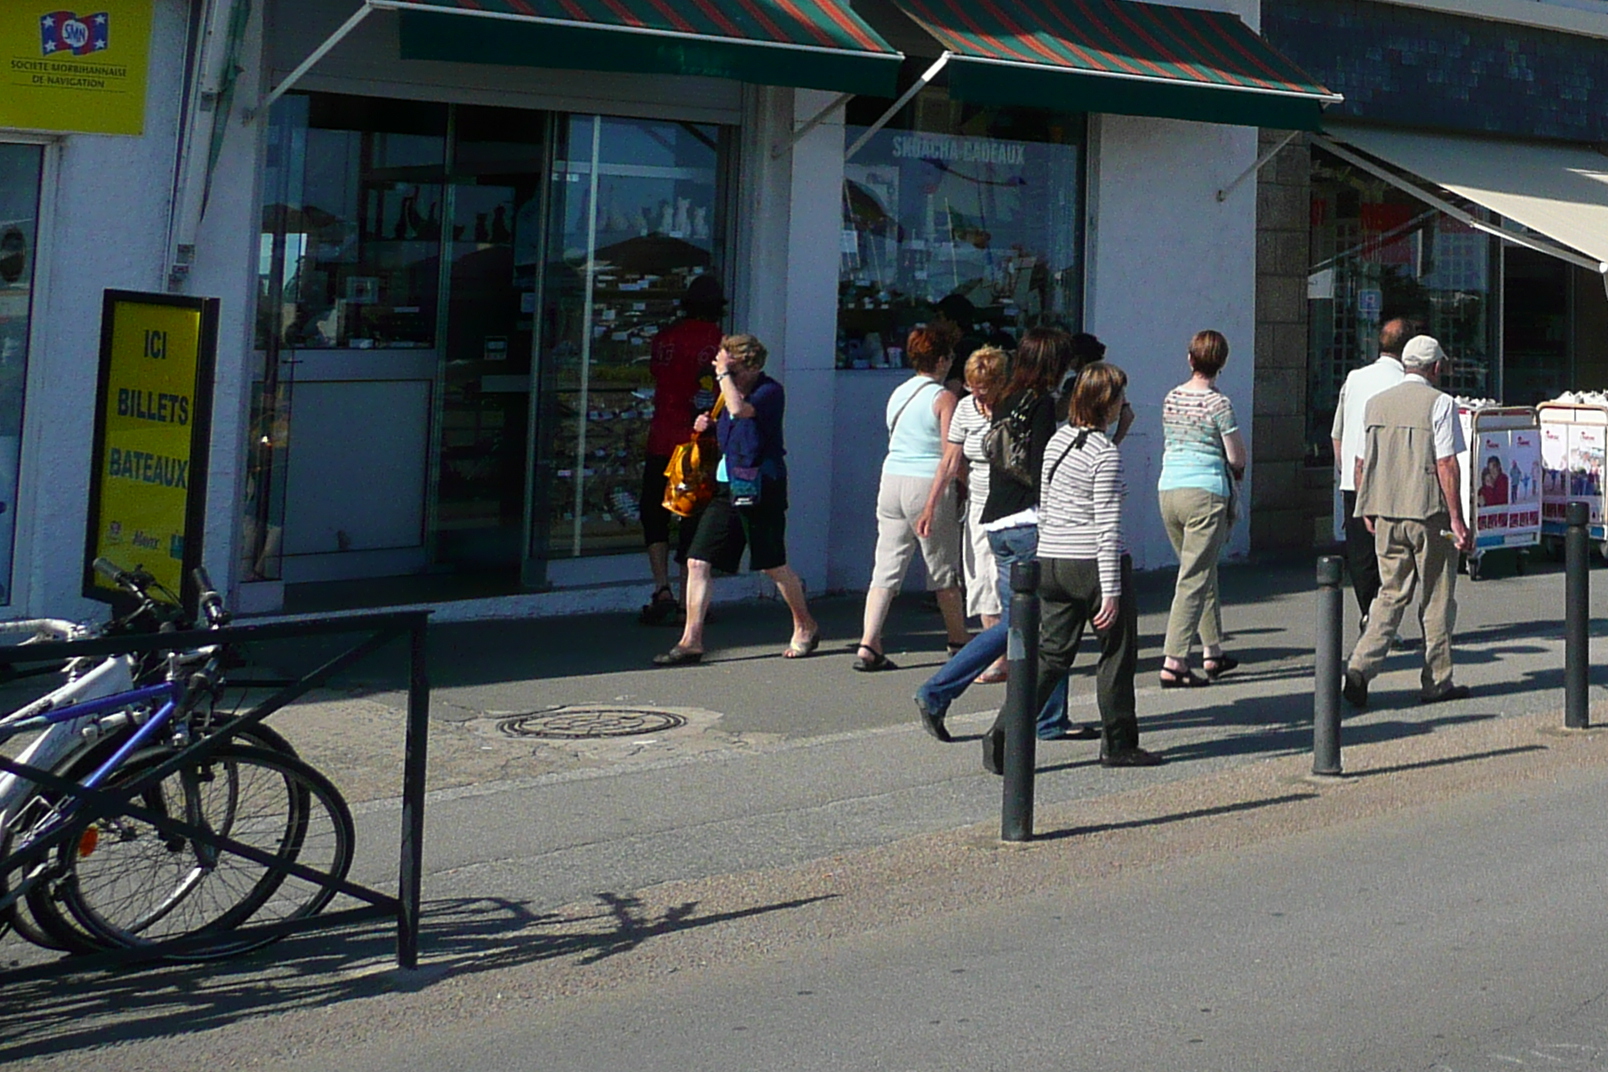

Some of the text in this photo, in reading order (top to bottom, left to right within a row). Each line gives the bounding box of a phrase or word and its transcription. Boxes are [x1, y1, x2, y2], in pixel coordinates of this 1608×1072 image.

[64, 23, 87, 44] SMN
[32, 75, 105, 89] DE NAVIGATION
[963, 141, 1026, 165] CADEAUX
[144, 330, 167, 359] ICI
[117, 388, 189, 425] BILLETS
[109, 447, 188, 489] BATEAUX
